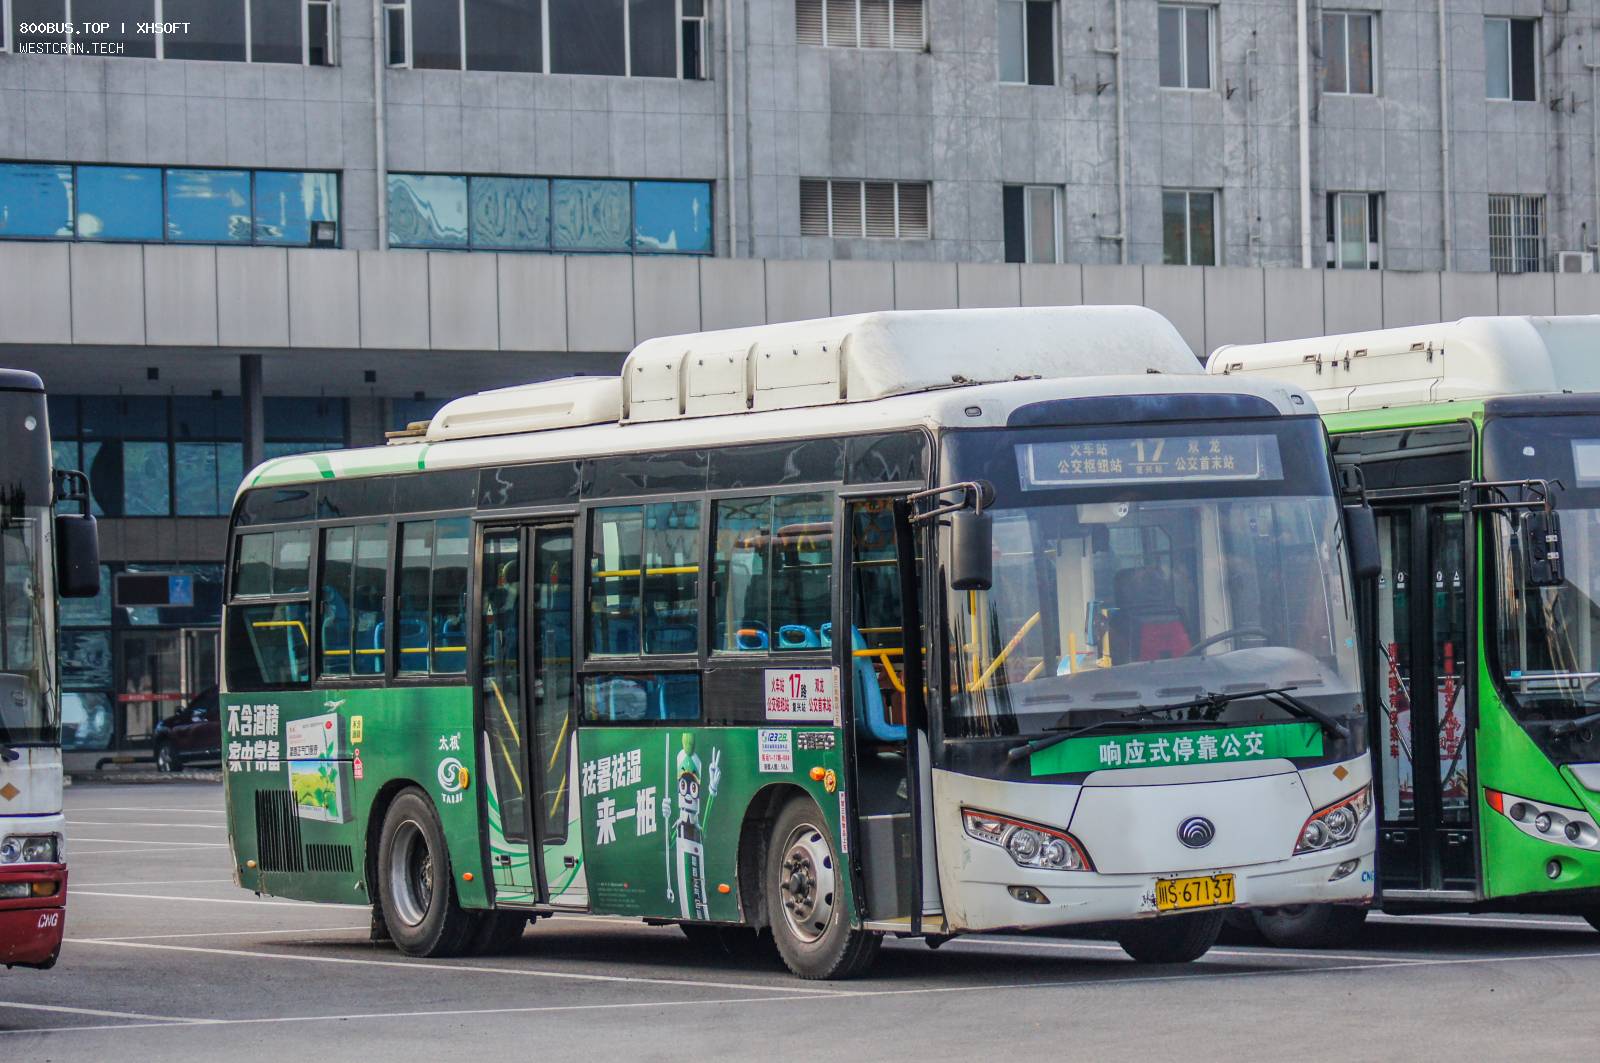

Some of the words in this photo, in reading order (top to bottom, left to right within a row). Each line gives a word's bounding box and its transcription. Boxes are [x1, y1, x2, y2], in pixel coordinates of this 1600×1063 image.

[1070, 443, 1108, 457] 火车站
[1130, 438, 1166, 462] 17
[1174, 456, 1236, 472] 公交首末站
[1057, 458, 1123, 474] 公交枢纽站
[228, 704, 279, 736] 不含酒精
[228, 740, 280, 772] 家中常备
[1099, 731, 1265, 765] 响应式停靠公交
[582, 749, 642, 797] 祛暑祛湿
[596, 786, 657, 846] 来一瓶
[37, 912, 59, 928] CNG
